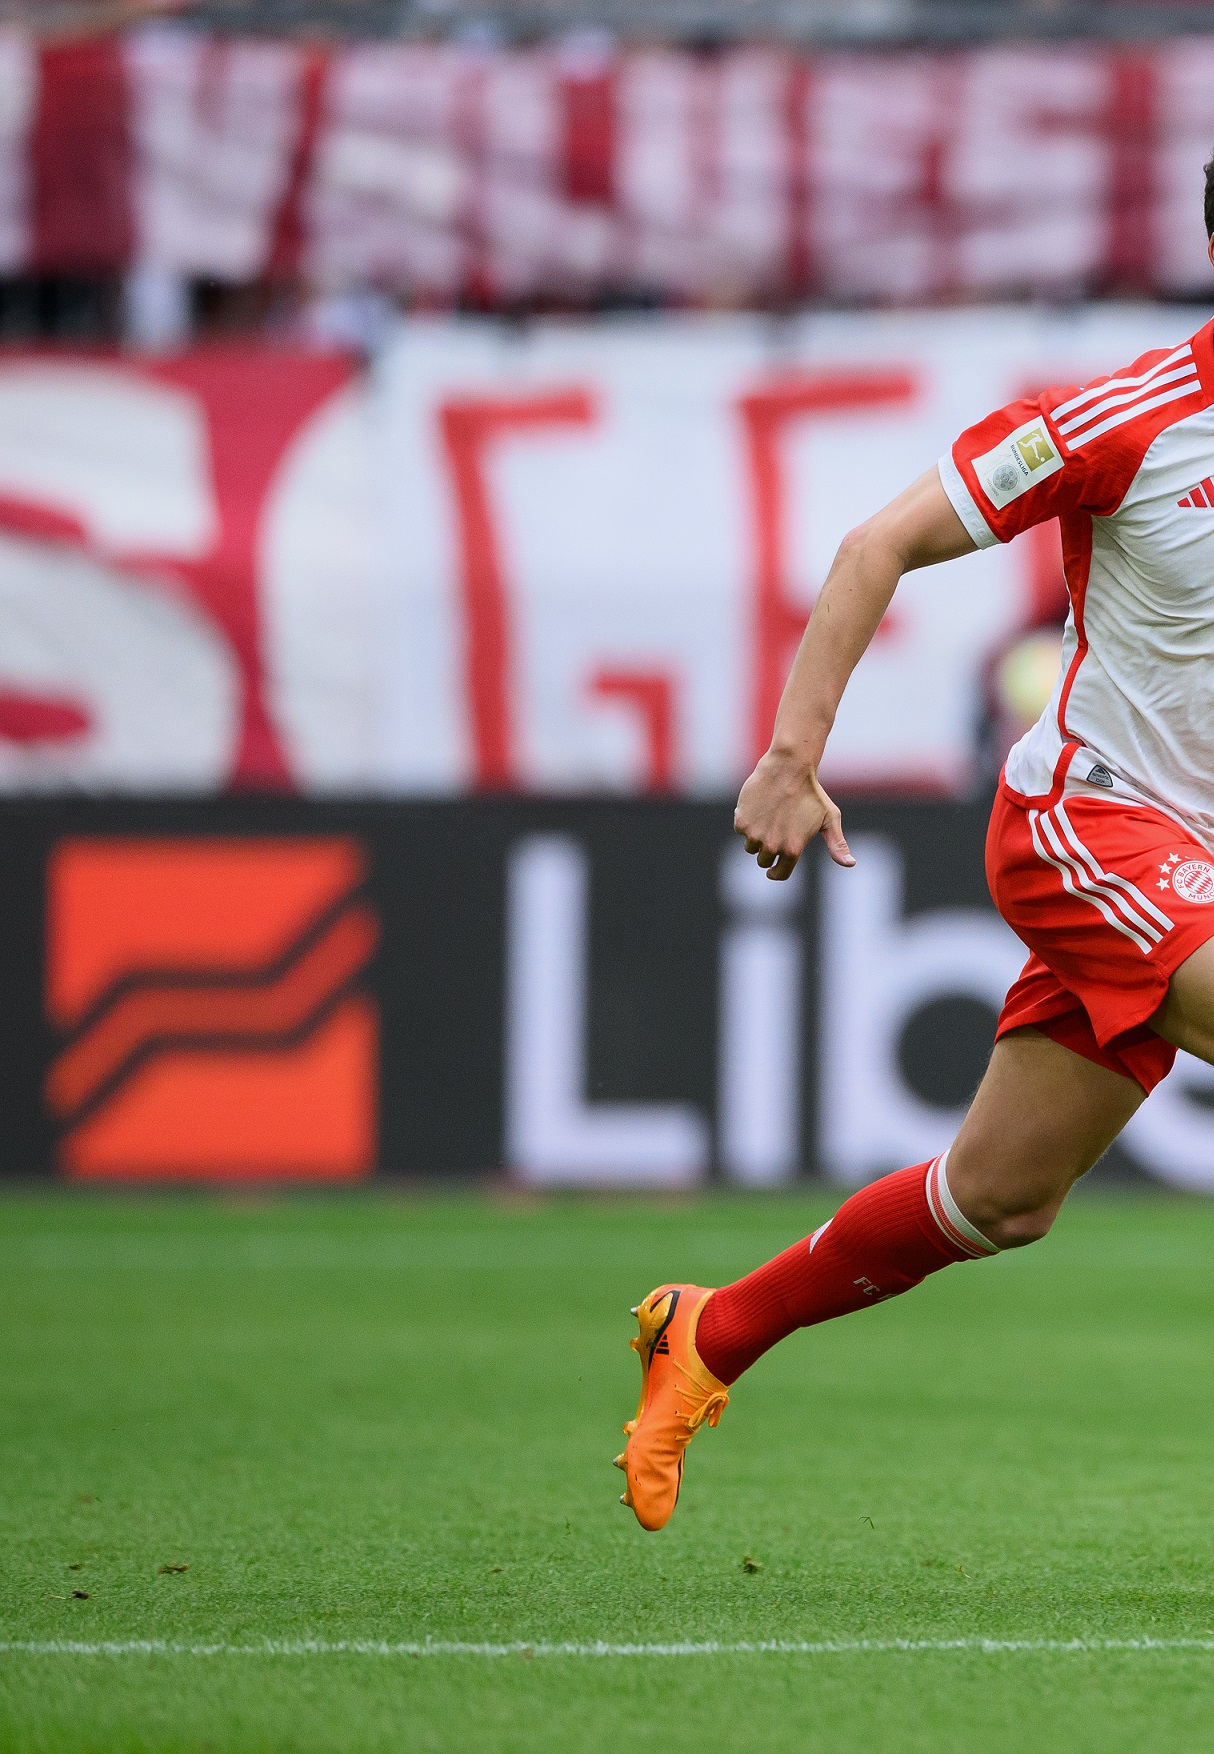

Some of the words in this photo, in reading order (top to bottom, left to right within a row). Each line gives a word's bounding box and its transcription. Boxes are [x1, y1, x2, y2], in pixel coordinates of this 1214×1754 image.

[1010, 444, 1029, 476] BUNDESLIGA
[1177, 863, 1211, 877] BAYERN
[853, 1276, 880, 1296] FC
